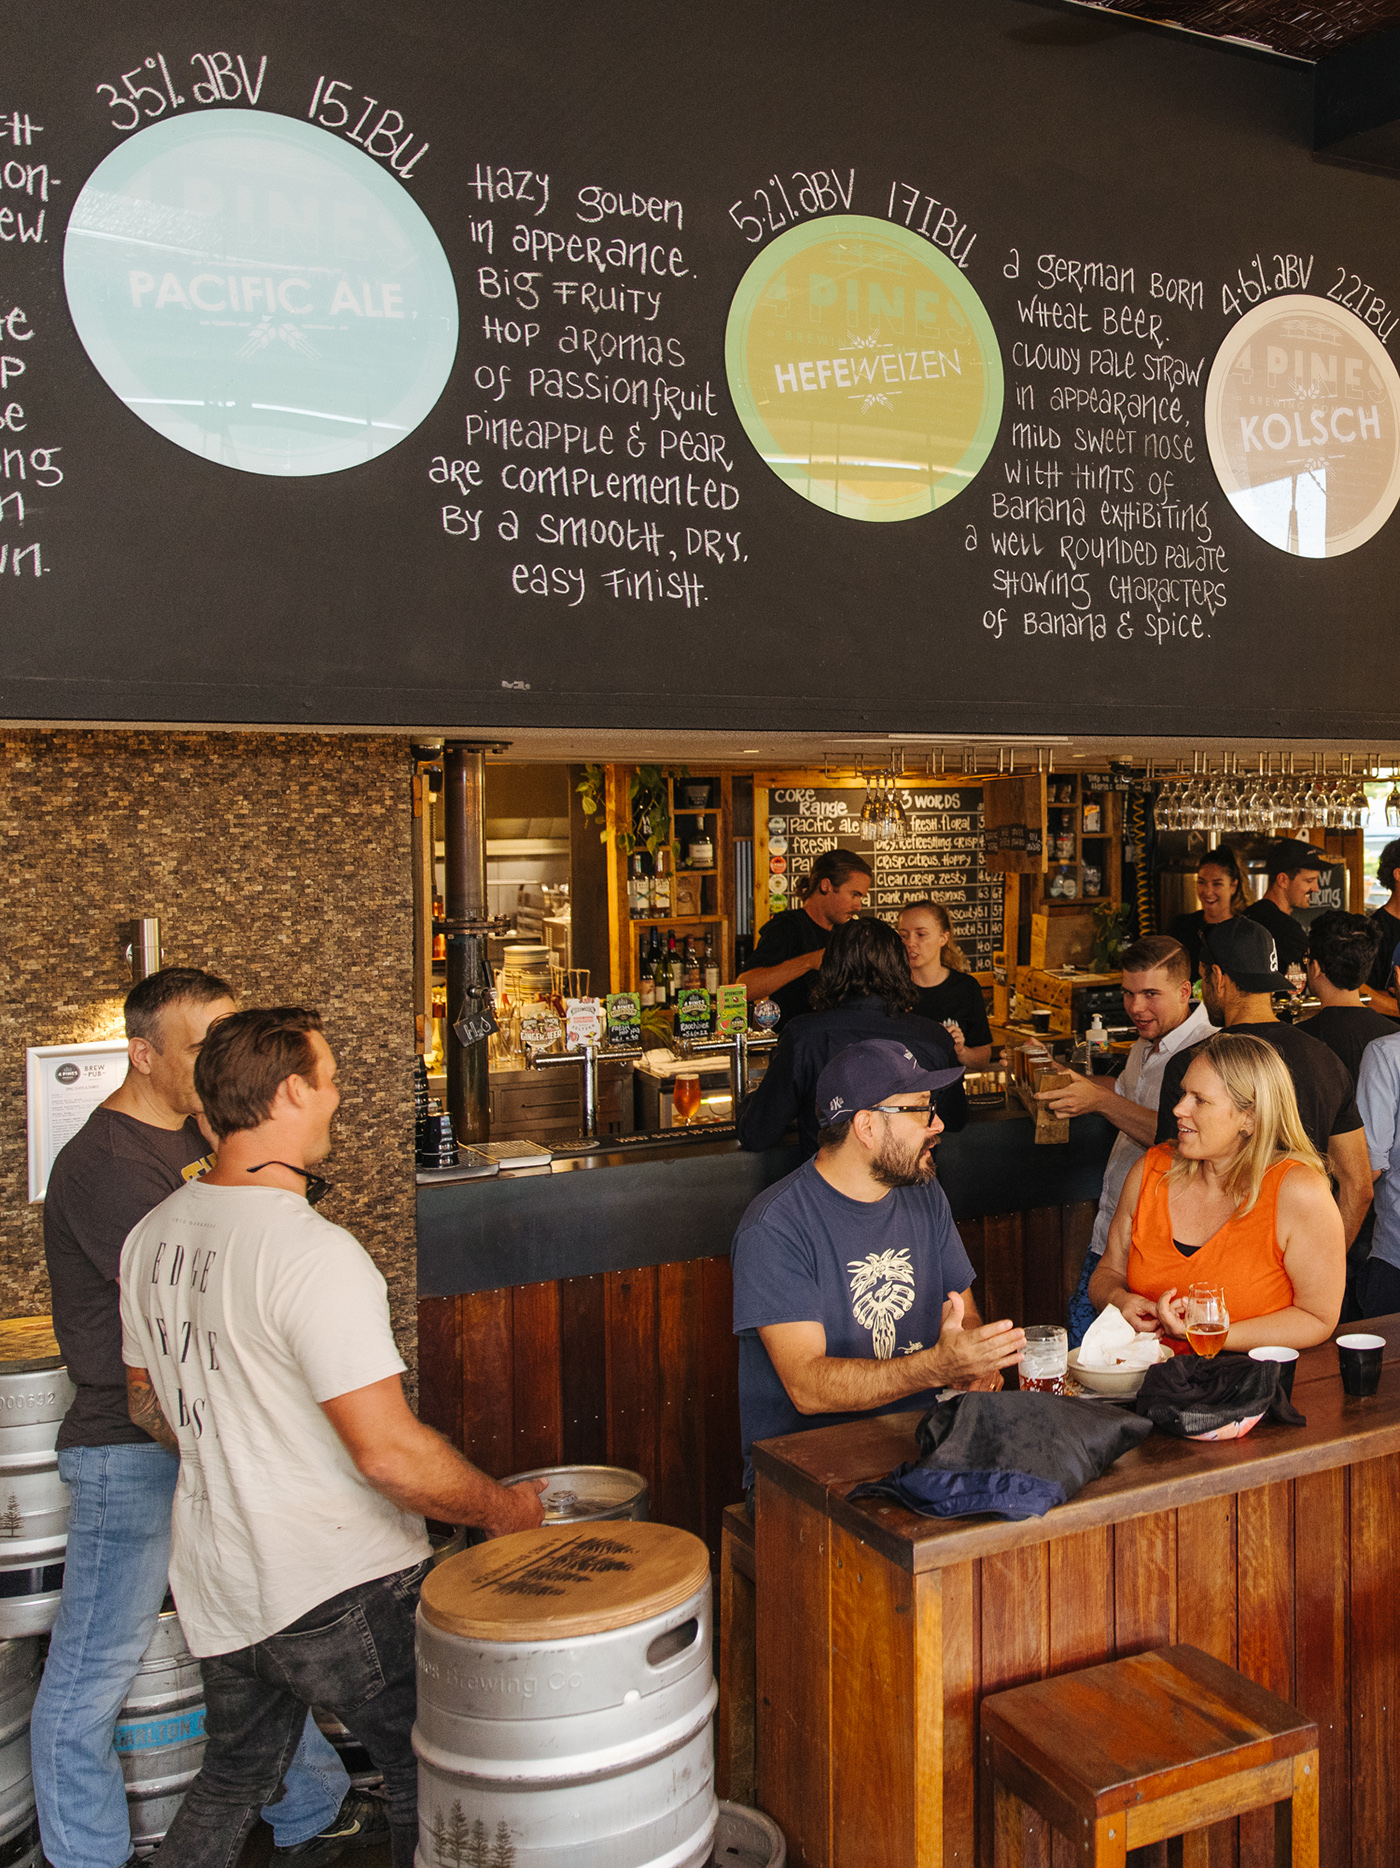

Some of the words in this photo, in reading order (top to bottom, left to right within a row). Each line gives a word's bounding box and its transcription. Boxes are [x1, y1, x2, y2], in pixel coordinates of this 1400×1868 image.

[468, 214, 494, 255] in
[128, 270, 314, 315] PACIFIC
[329, 281, 405, 318] ALE
[761, 270, 790, 318] 4
[809, 273, 972, 344] PINES
[474, 365, 512, 402] of
[773, 349, 963, 393] HEFEWEIZEN
[1231, 344, 1254, 385] 4
[1267, 346, 1387, 403] PINES
[626, 421, 647, 458] &
[1240, 405, 1381, 452] KOLSCH
[497, 509, 519, 542] a
[448, 1670, 538, 1698] Brewing
[549, 1671, 583, 1690] Co
[113, 1719, 191, 1747] CARLTON
